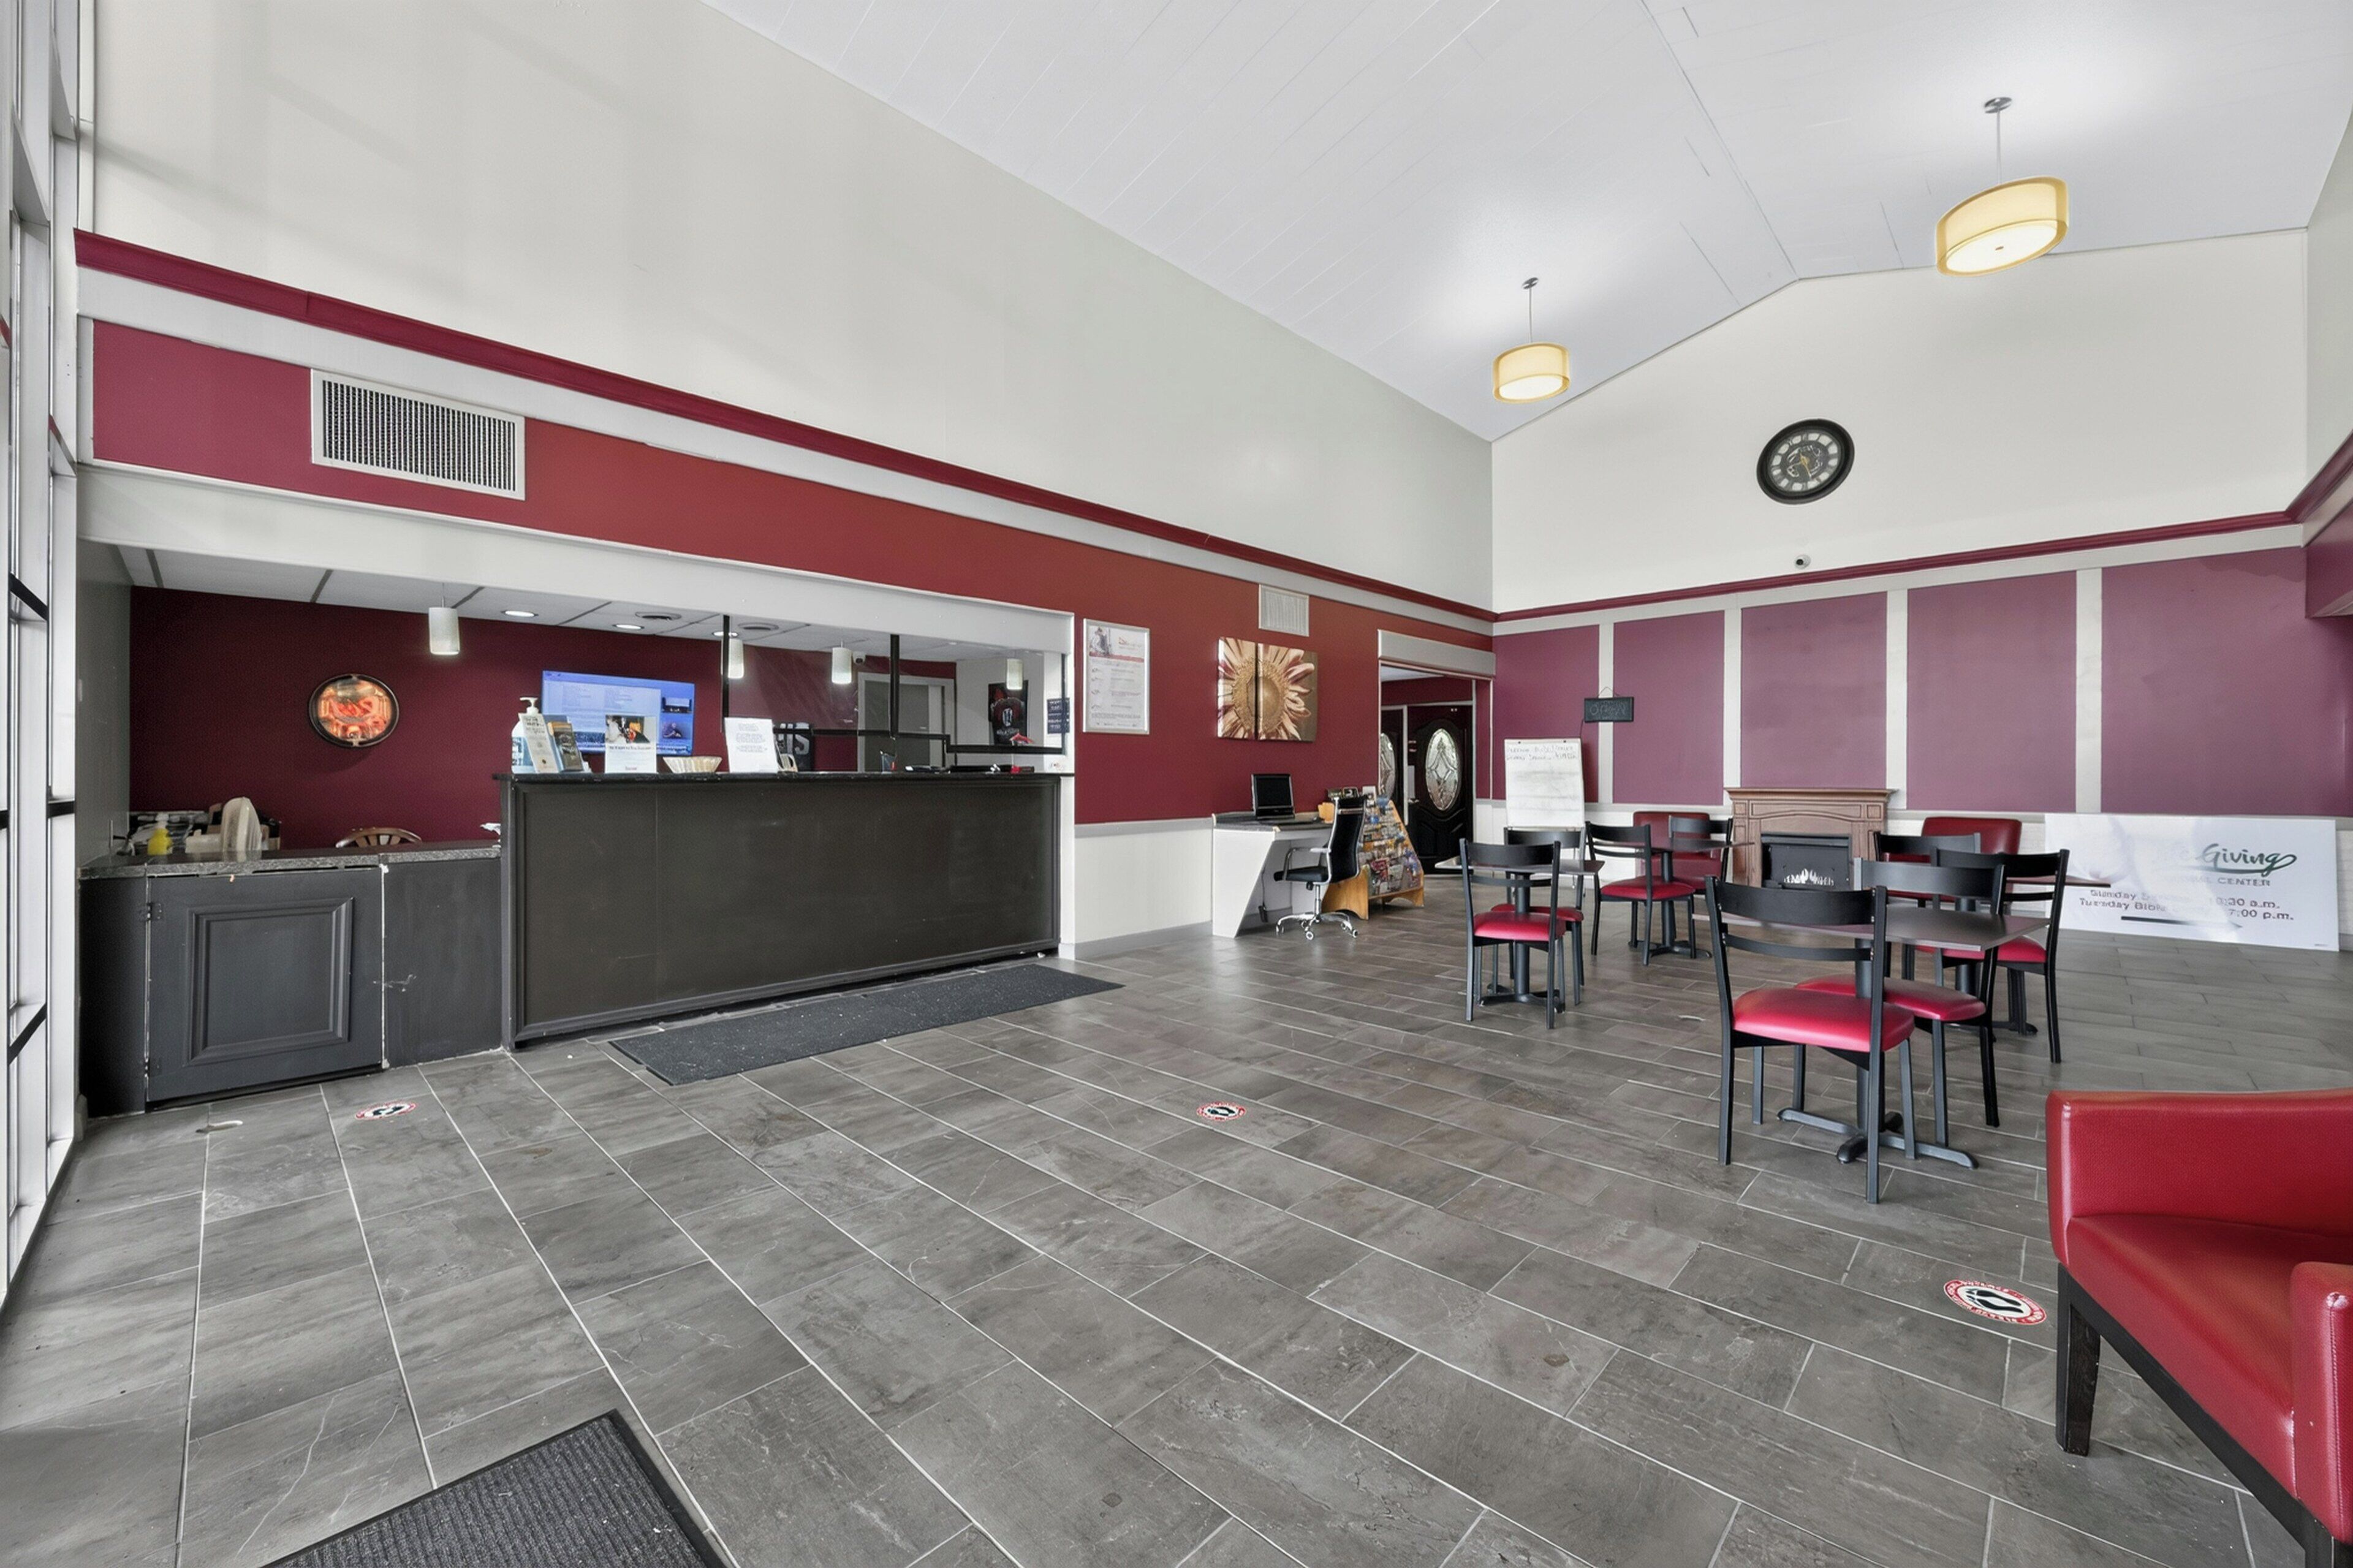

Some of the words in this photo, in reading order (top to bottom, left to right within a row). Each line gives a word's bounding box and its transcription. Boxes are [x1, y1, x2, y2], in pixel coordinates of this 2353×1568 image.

[2217, 877, 2270, 887] CENTER
[2090, 889, 2137, 901] Sunday
[2079, 897, 2130, 911] Tuesday
